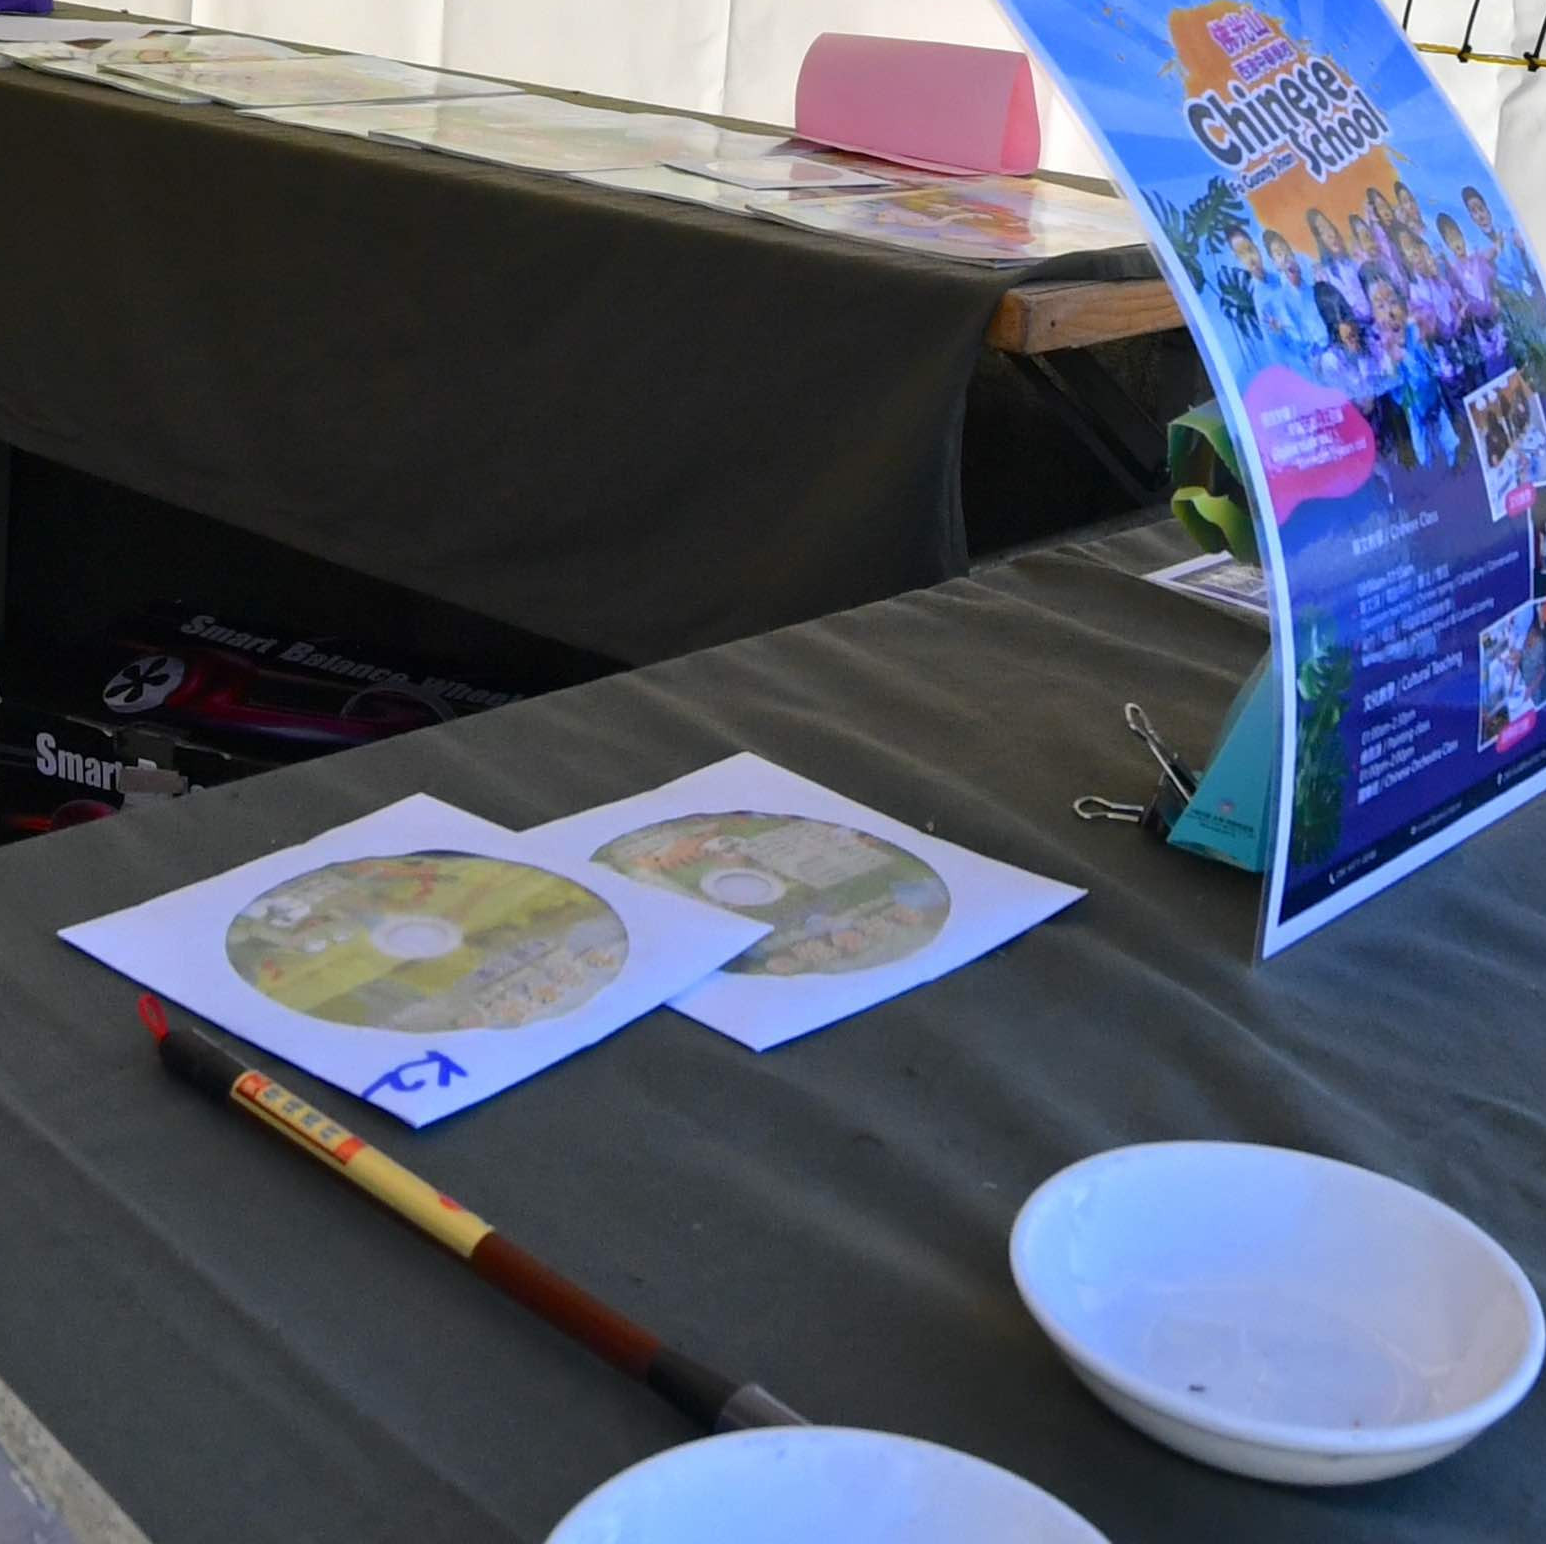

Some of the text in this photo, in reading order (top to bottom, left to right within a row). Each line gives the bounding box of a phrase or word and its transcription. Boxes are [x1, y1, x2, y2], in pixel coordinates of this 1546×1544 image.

[1187, 60, 1348, 166] Chinese
[1285, 89, 1389, 177] School
[180, 614, 279, 654] Smart
[278, 639, 412, 686] Balance
[34, 732, 122, 793] Smart
